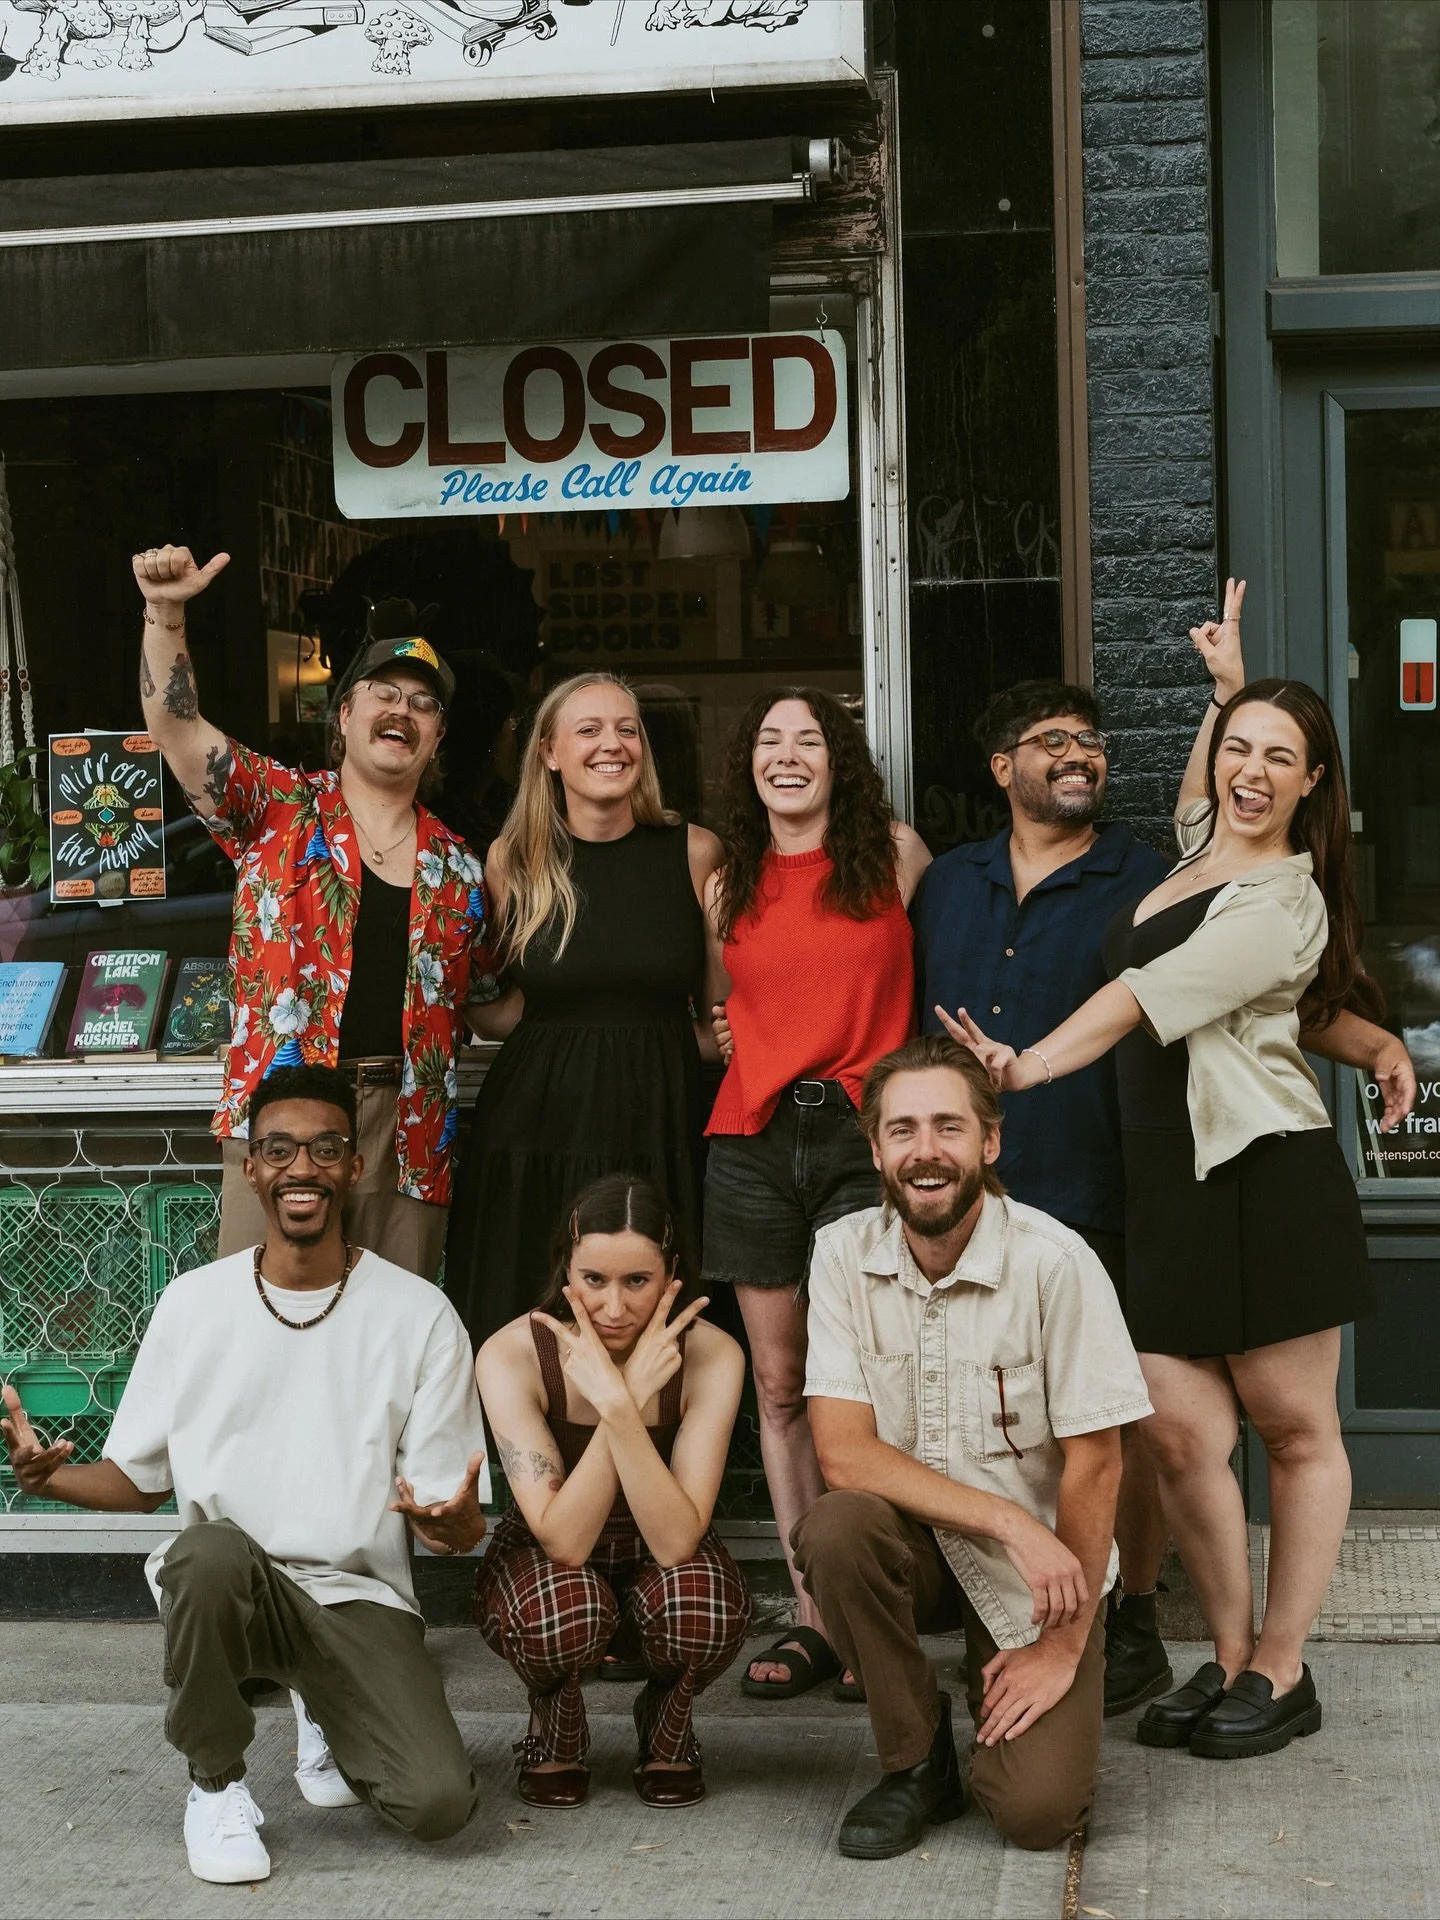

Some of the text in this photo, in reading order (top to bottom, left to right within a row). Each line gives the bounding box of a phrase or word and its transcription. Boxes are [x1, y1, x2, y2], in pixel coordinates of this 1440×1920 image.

[343, 335, 838, 468] CLOSED
[441, 460, 753, 506] Please Call Again
[550, 561, 651, 588] LAST
[548, 591, 709, 618] SUPPER
[550, 622, 680, 653] BOOKS
[59, 752, 158, 805] Mirrors
[56, 822, 160, 873] the ALBUM
[91, 953, 160, 966] CREATION
[105, 966, 140, 978] LAKE
[0, 1021, 33, 1030] therine
[83, 1020, 134, 1033] RACHEL
[74, 1033, 139, 1046] KUSHNER
[1405, 1111, 1440, 1134] fra
